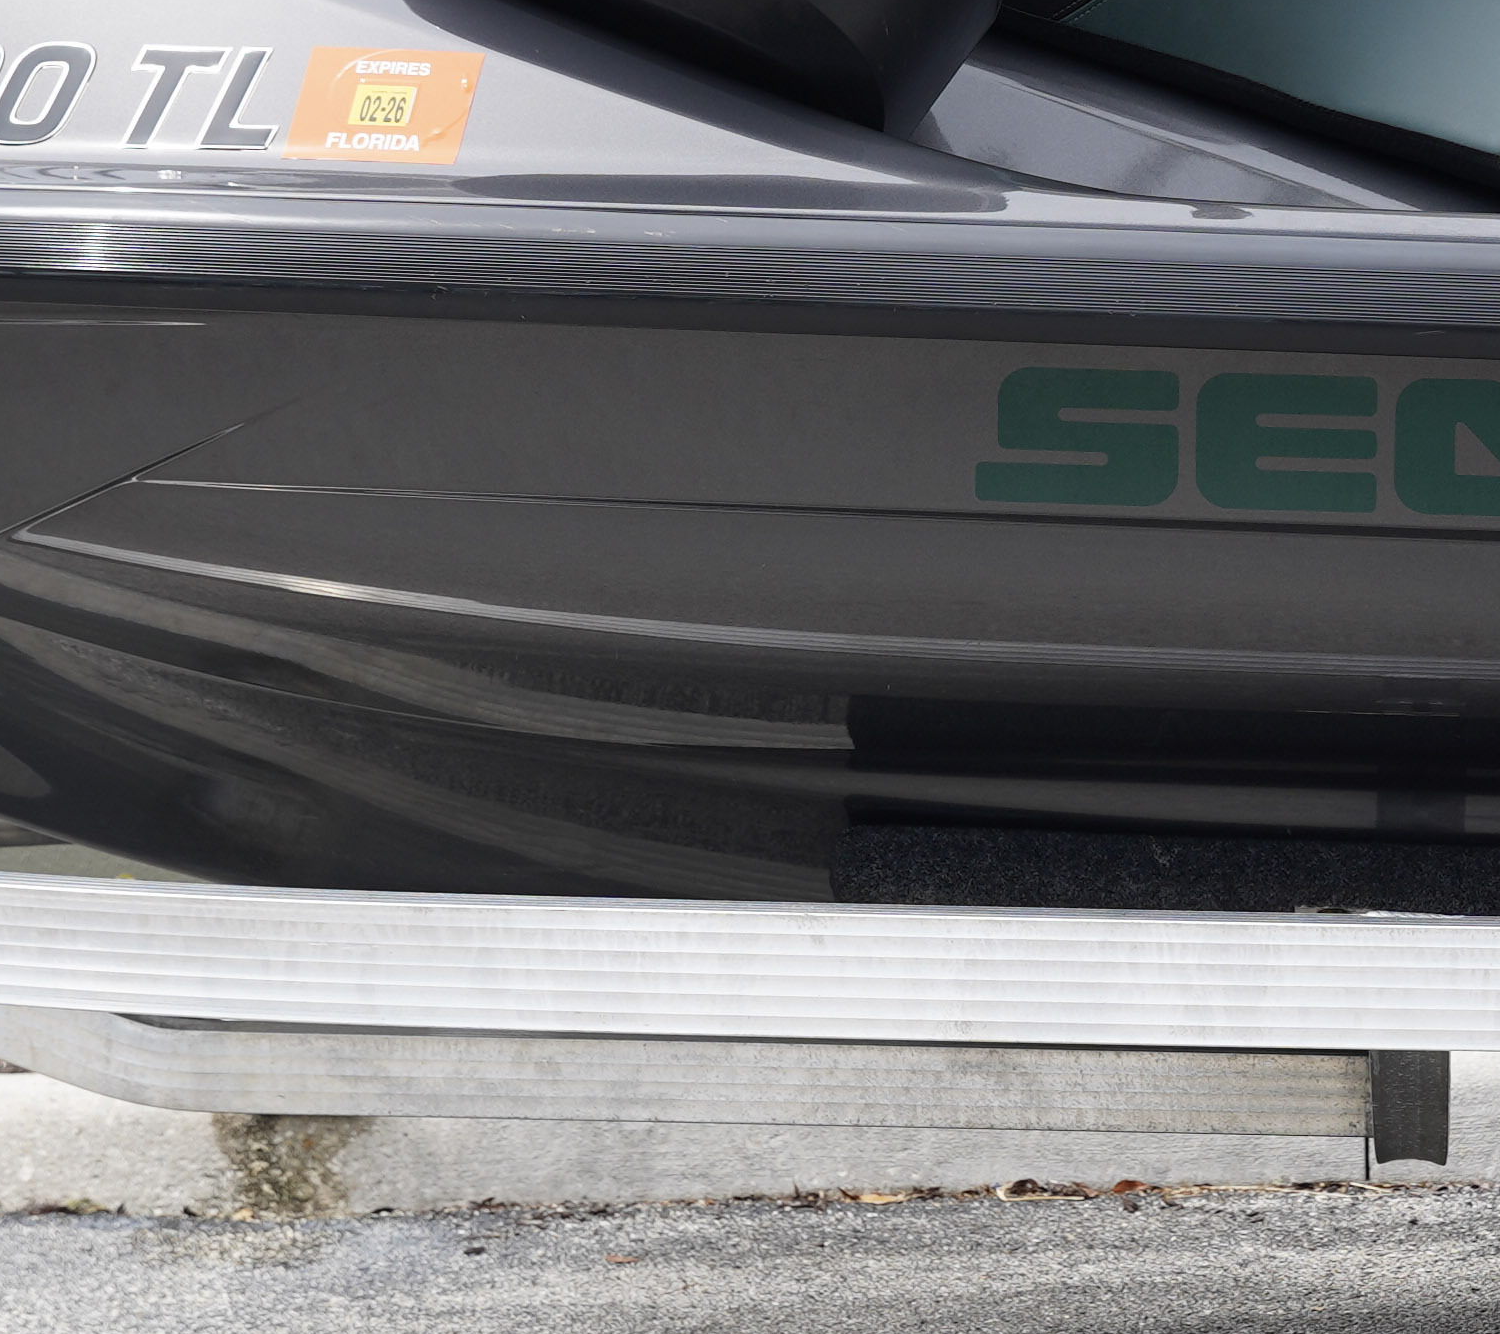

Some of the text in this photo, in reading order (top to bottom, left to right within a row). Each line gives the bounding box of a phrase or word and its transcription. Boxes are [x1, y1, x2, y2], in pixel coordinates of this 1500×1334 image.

[355, 59, 432, 77] EXPIRES
[121, 44, 280, 152] TL
[324, 131, 421, 152] FLORIDA
